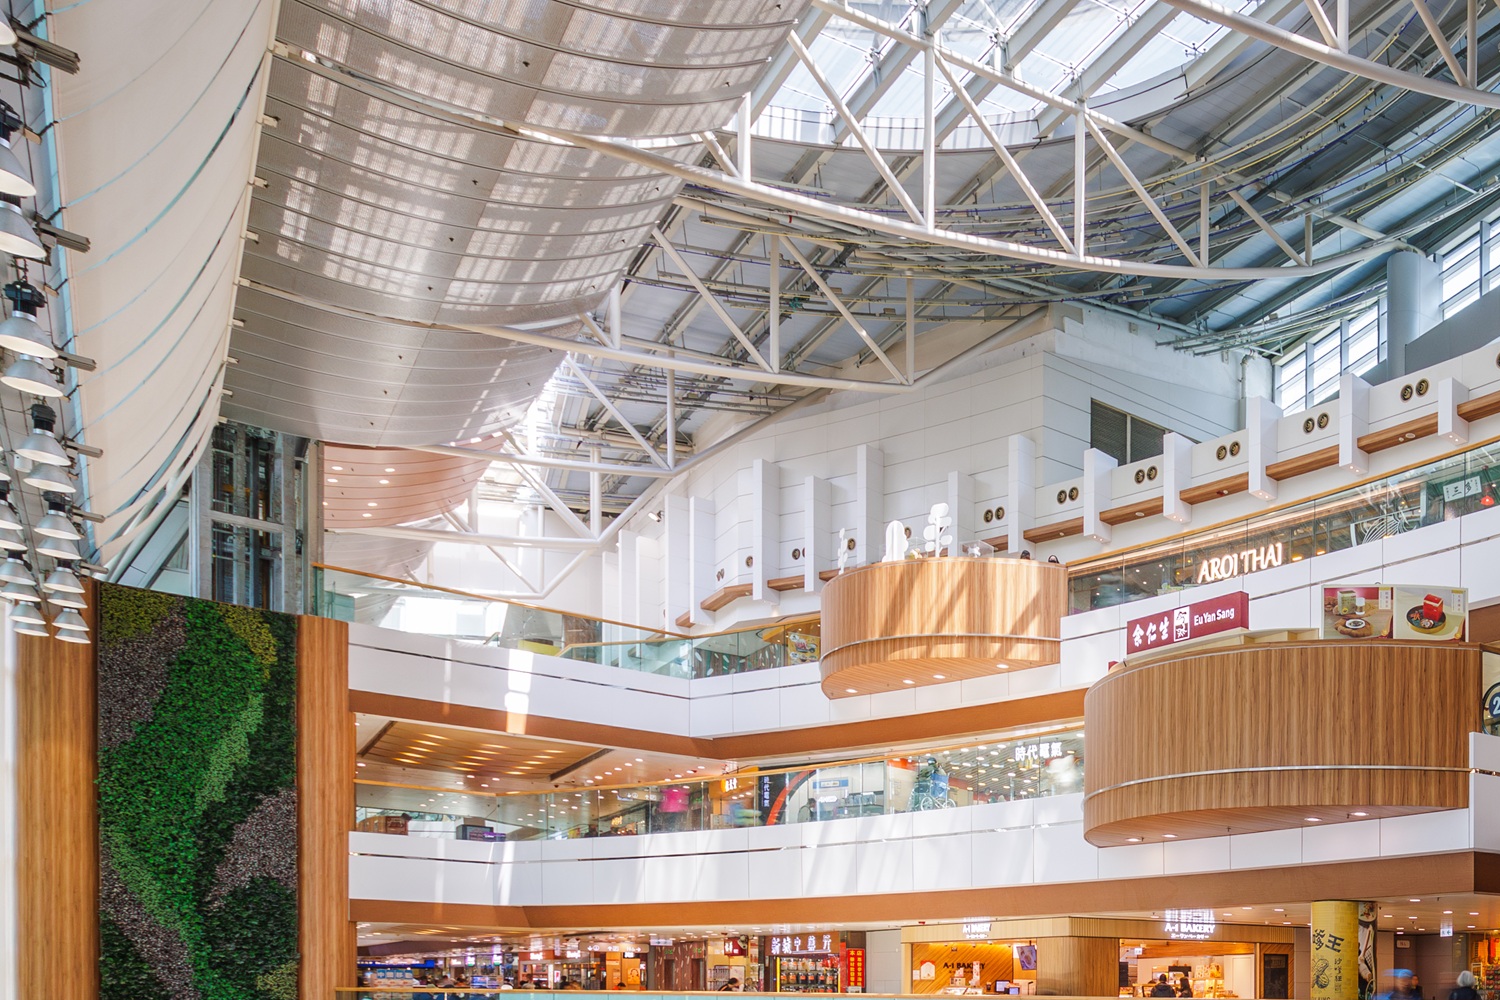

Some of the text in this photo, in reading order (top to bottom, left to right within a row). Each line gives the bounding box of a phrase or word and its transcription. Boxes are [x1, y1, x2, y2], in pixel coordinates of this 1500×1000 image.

[1197, 542, 1283, 583] AROI THAI
[1194, 607, 1235, 626] Eu Yan Sang
[1132, 616, 1170, 647] 余仁生
[1180, 923, 1215, 933] BAKERY
